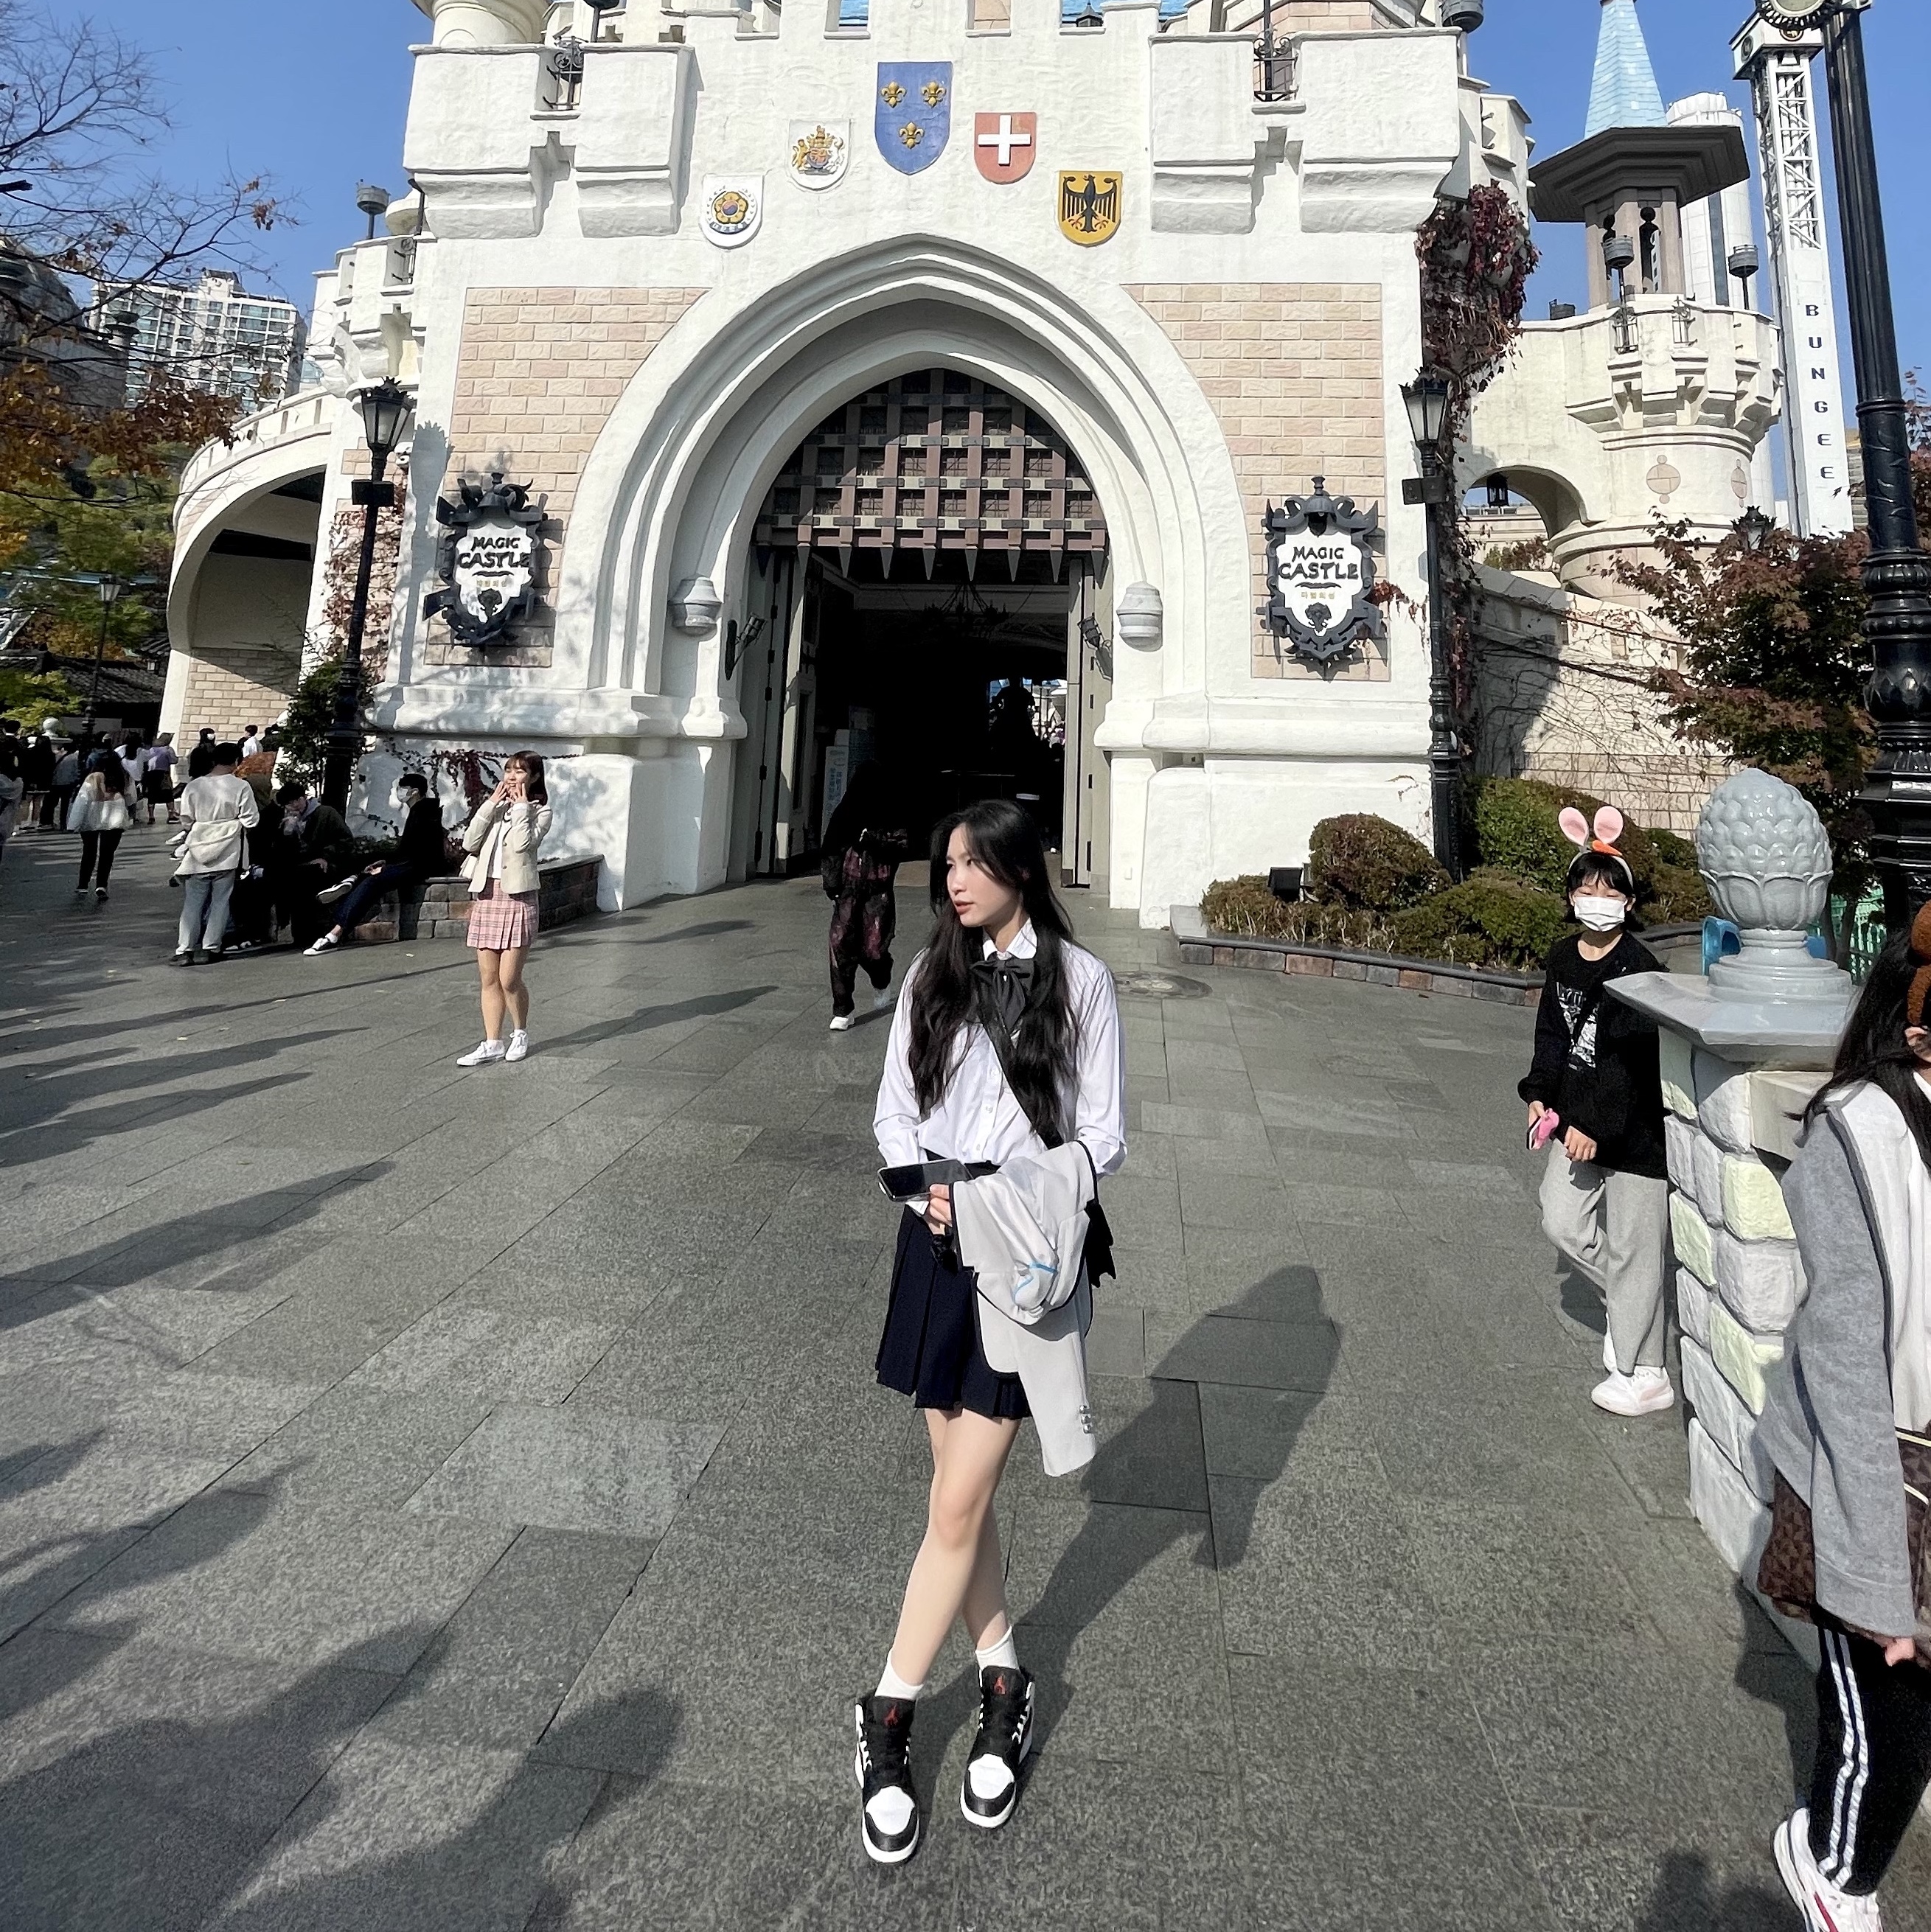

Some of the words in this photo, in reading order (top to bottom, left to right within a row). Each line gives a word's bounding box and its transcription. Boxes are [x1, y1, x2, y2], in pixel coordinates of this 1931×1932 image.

[1805, 304, 1835, 479] BUNGEE
[470, 537, 521, 551] MAGIC
[456, 552, 531, 569] CASTLE
[1291, 546, 1345, 562] MAGIC
[1278, 562, 1359, 580] CASTLE
